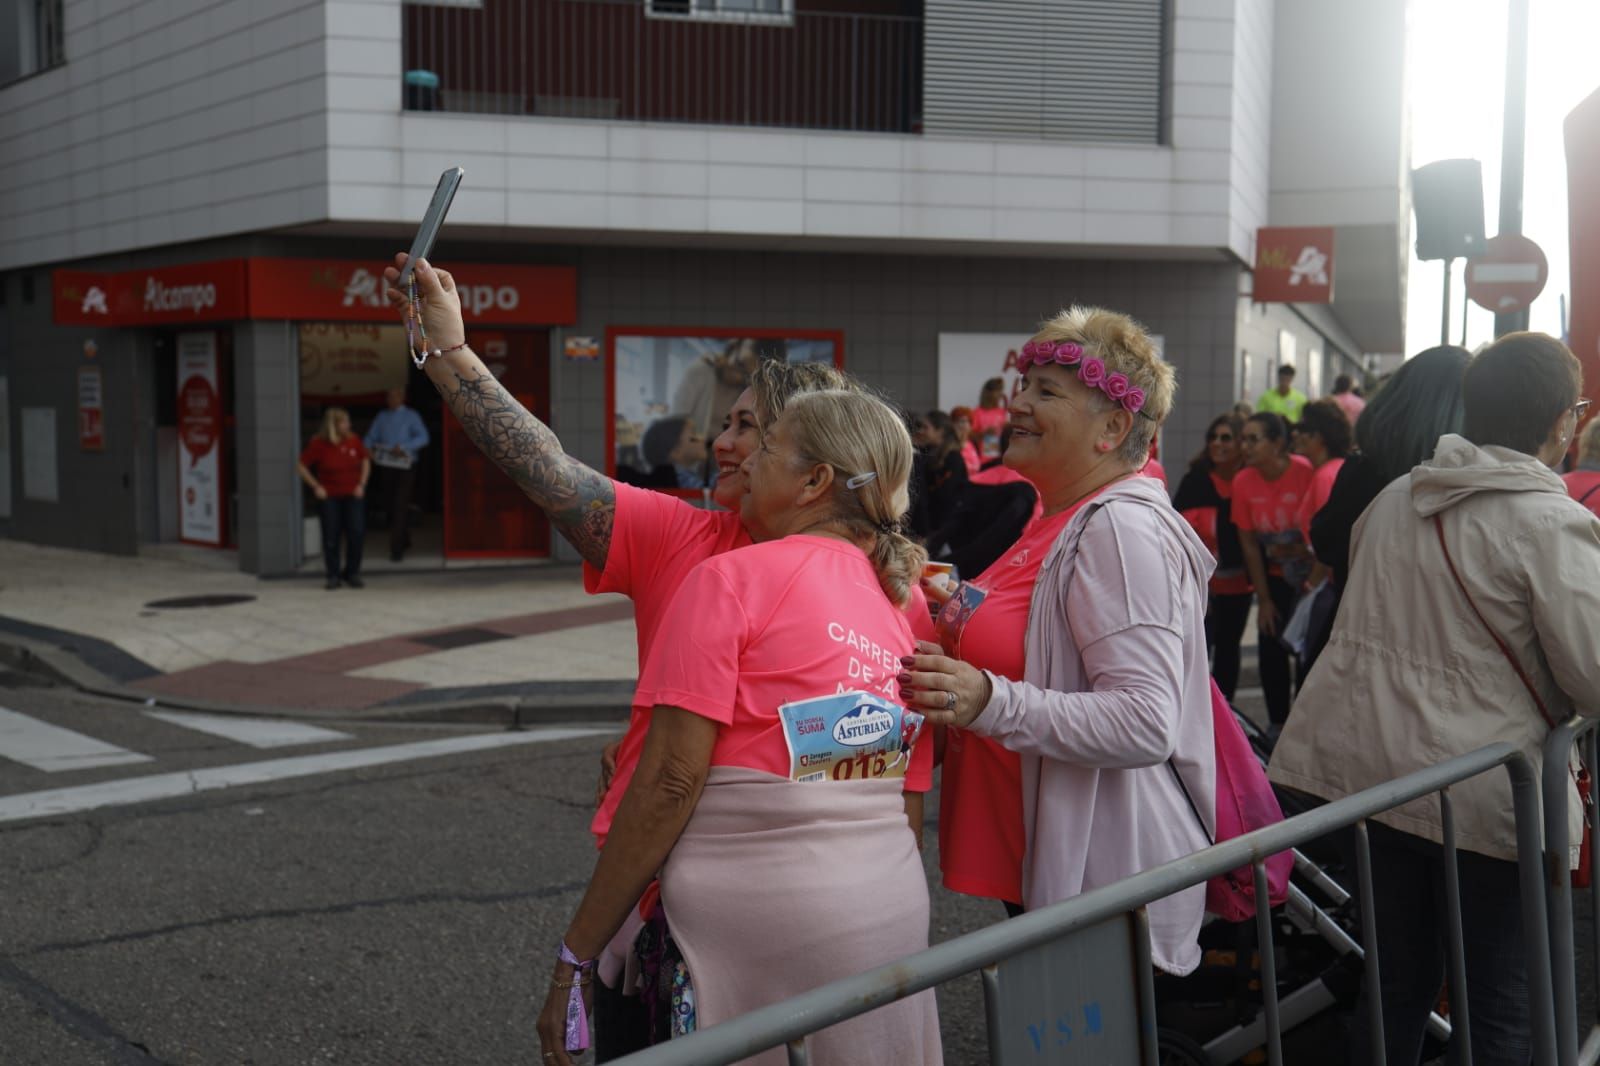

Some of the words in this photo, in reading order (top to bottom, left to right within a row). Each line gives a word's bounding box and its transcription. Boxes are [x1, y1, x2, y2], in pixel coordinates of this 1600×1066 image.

[143, 276, 217, 313] Alcampo
[828, 622, 902, 674] CARRER
[848, 656, 873, 684] DE
[798, 722, 825, 736] SUMA
[837, 720, 891, 741] ASTURIANA
